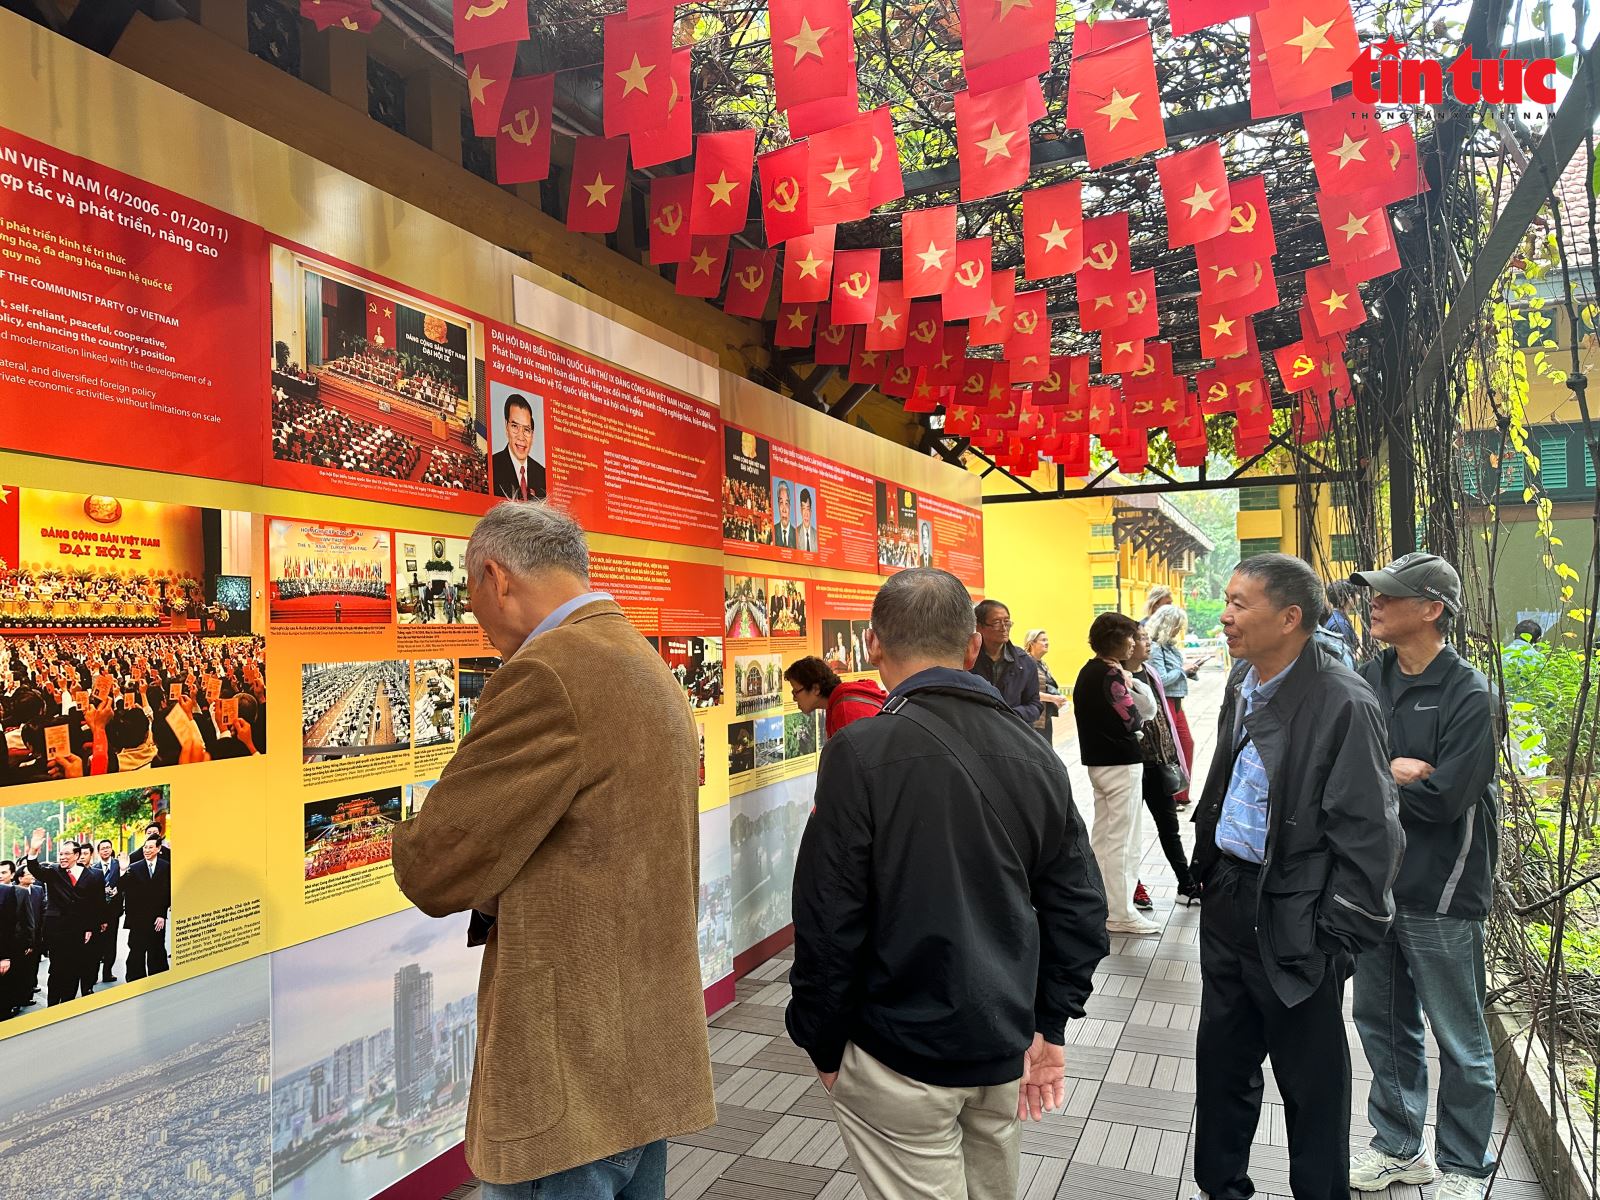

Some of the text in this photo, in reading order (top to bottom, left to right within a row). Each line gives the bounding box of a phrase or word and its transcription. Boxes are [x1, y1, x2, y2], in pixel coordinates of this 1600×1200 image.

[21, 153, 59, 179] VIỆT
[63, 169, 101, 196] NAM
[105, 185, 160, 216] (4/2006
[171, 211, 228, 244] 01/2011)
[27, 181, 53, 200] tác
[56, 193, 75, 208] và
[79, 201, 114, 222] phát
[118, 213, 155, 238] triển,
[159, 230, 193, 252] nâng
[196, 243, 218, 258] cao
[2, 249, 41, 265] quy mô
[6, 221, 30, 235] phát
[33, 229, 57, 243] triển
[59, 236, 80, 250] kinh
[83, 245, 92, 254] tế
[94, 248, 104, 258] tri
[106, 252, 126, 265] thức
[18, 237, 41, 253] hóa,
[43, 246, 56, 256] đa
[58, 250, 82, 266] dạng
[85, 258, 102, 270] hóa
[104, 266, 127, 278] quan
[129, 271, 140, 284] hệ
[142, 278, 162, 289] quốc
[164, 283, 173, 292] tế
[8, 272, 28, 286] THE
[31, 279, 93, 303] COMMUNIST
[96, 297, 124, 312] PARTY
[127, 306, 138, 315] OF
[140, 309, 179, 327] VIETNAM
[10, 303, 68, 324] self-reliant,
[70, 318, 112, 335] peaceful,
[114, 330, 168, 350] cooperative,
[27, 321, 78, 342] enhancing
[81, 333, 96, 344] the
[98, 339, 139, 354] country's
[141, 350, 175, 363] position
[10, 334, 79, 356] modernization
[81, 348, 108, 362] linked
[110, 357, 128, 367] with
[130, 361, 144, 371] the
[146, 364, 196, 383] development
[198, 377, 206, 385] of
[28, 379, 74, 394] economic
[76, 389, 114, 402] activities
[116, 396, 148, 409] without
[150, 402, 190, 417] limitations
[204, 414, 221, 423] scale
[31, 366, 49, 376] and
[52, 369, 98, 386] diversified
[100, 378, 130, 394] foreign
[132, 388, 156, 400] policy
[41, 527, 160, 548] ĐẢNG CỘNG SẢN VIỆT NAM
[59, 543, 142, 560] ĐẠI HỘI X
